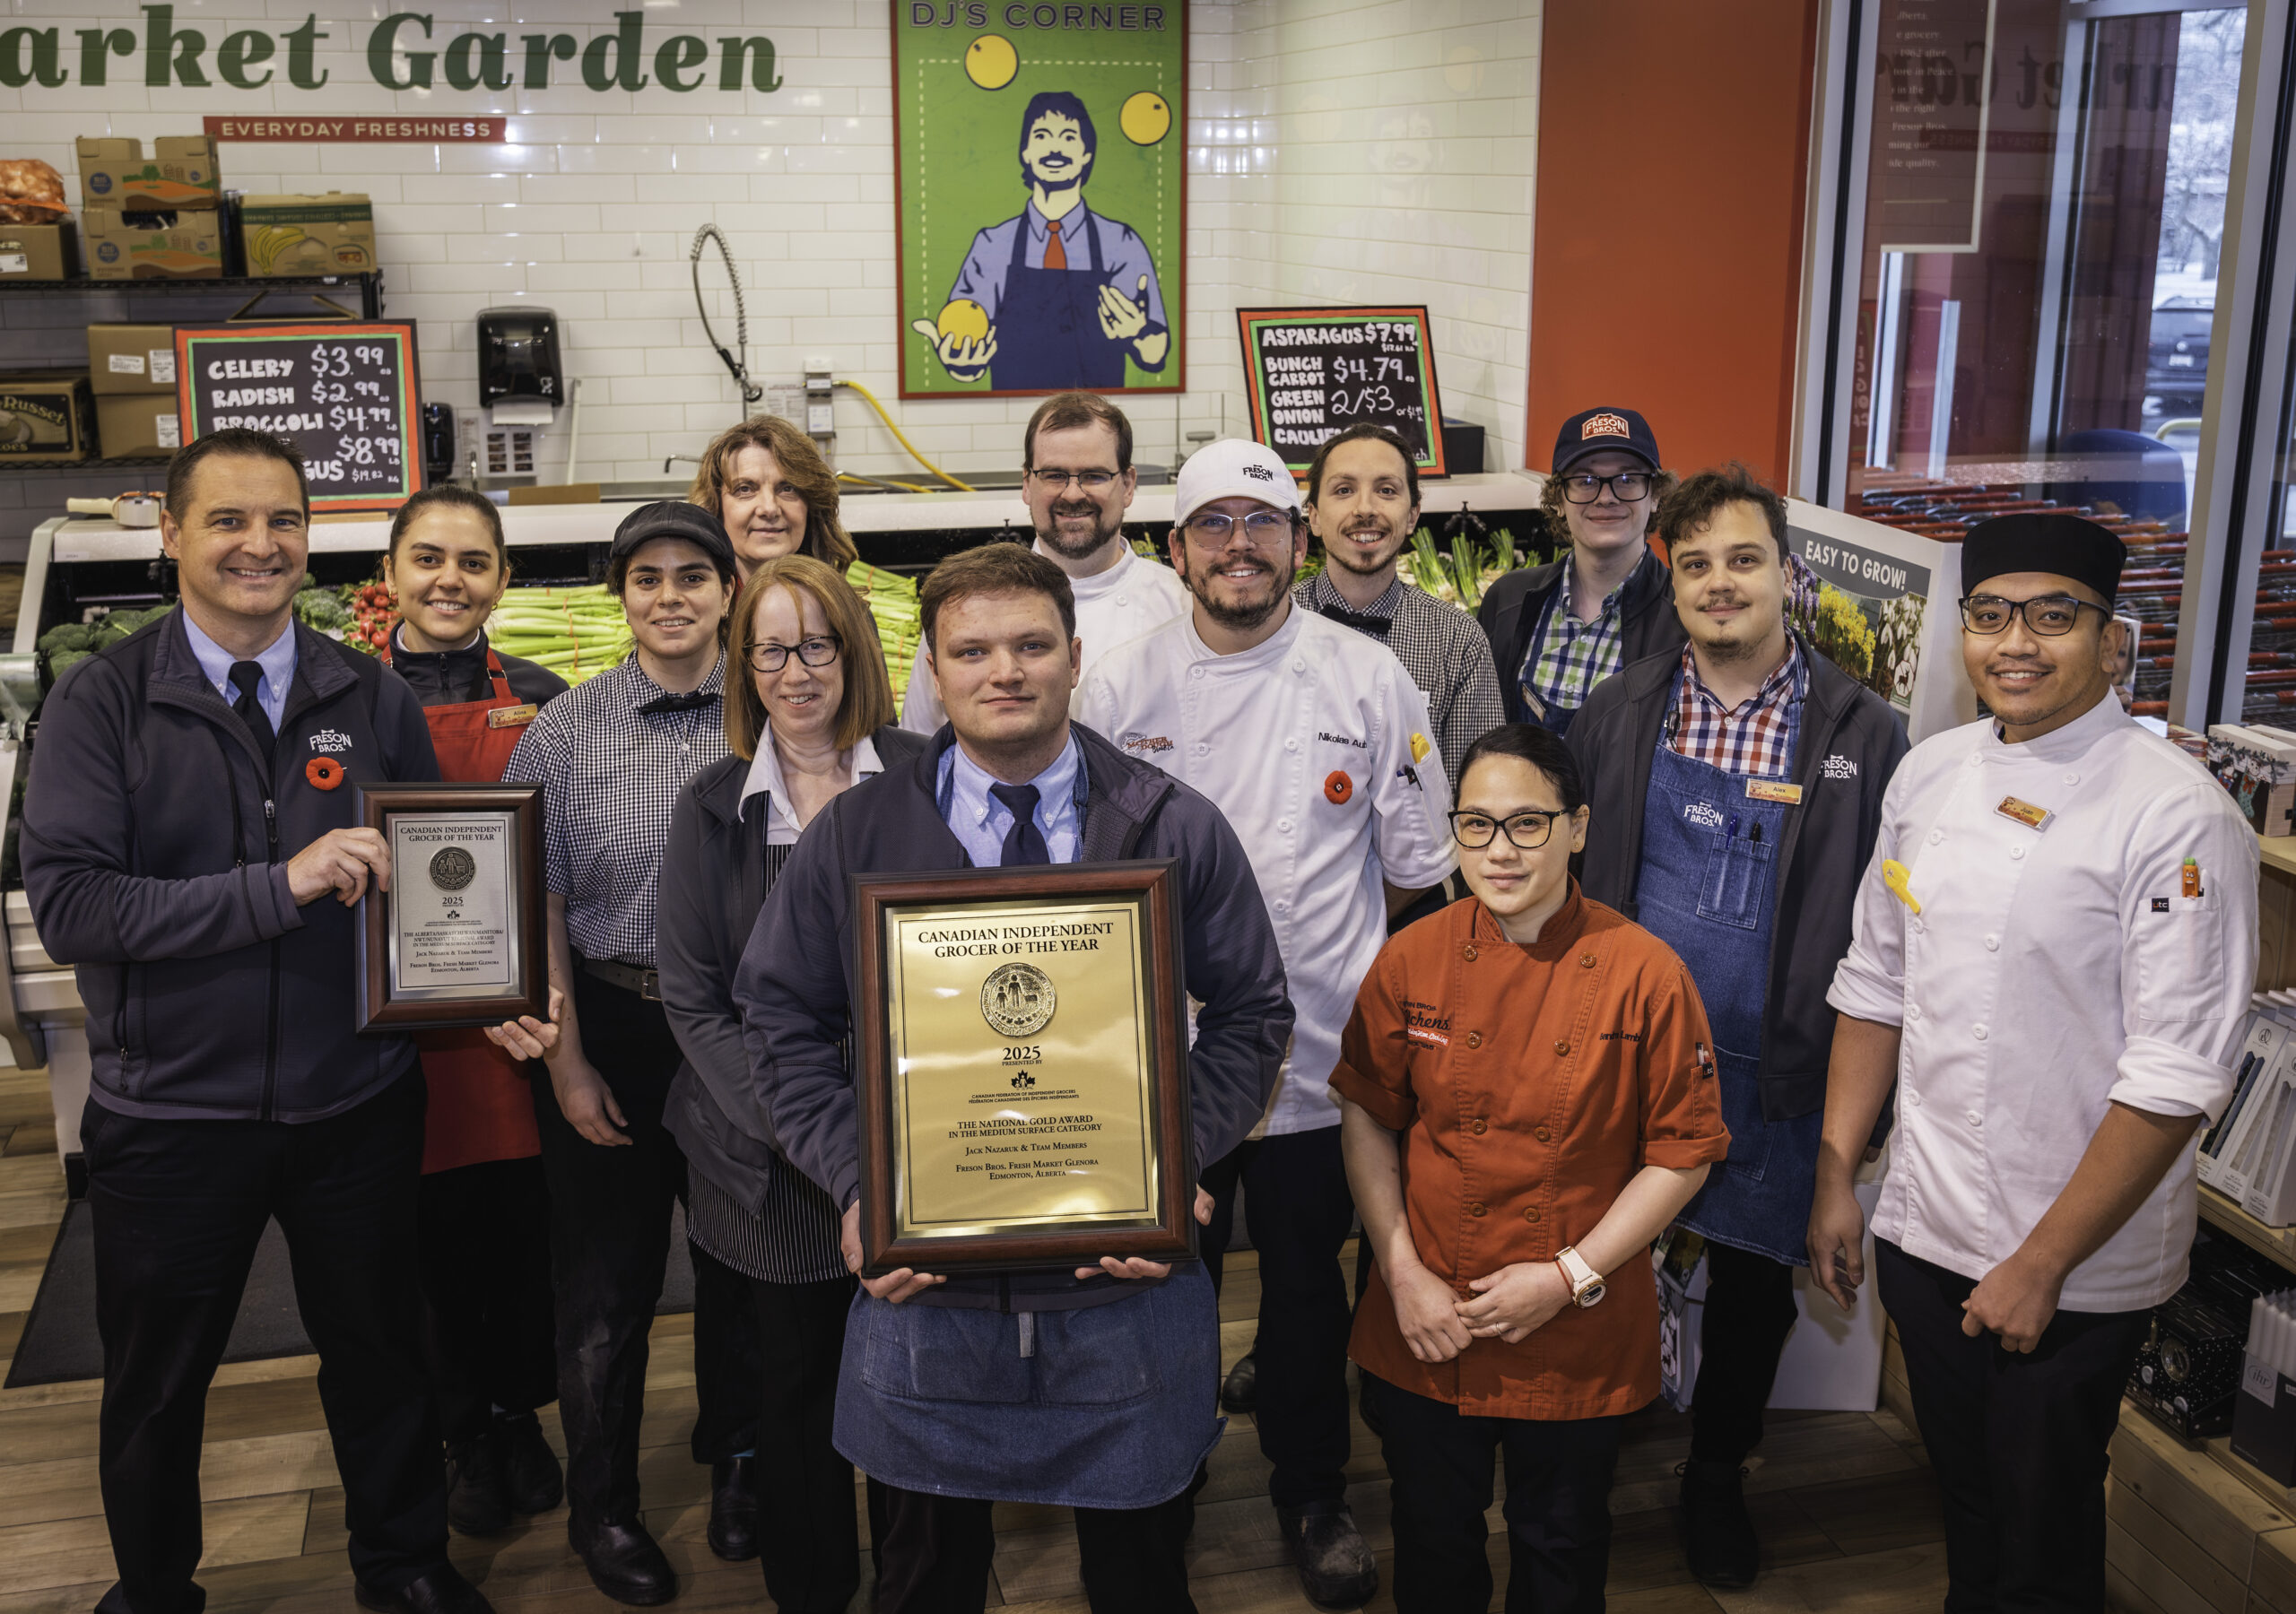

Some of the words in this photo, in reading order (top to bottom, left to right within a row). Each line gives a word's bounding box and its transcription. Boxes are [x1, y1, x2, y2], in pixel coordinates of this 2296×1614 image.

[910, 1, 990, 29] DJ'S
[1002, 4, 1166, 30] CORNER
[0, 4, 331, 91] arket
[367, 11, 784, 93] Garden
[222, 122, 344, 136] EVERYDAY
[355, 122, 491, 136] FRESHNESS
[1262, 326, 1364, 346] ASPARAGUS
[1364, 322, 1415, 344] $7.99
[208, 359, 294, 380] CELERY
[310, 343, 384, 377] $3.99
[1265, 357, 1323, 373] BUNCH
[1333, 356, 1404, 383] $4.79
[1268, 371, 1326, 386] CARROT
[212, 386, 295, 409] RADISH
[311, 380, 379, 404] $2.99
[1271, 389, 1325, 407] GREEN
[1331, 386, 1395, 414] 2/$3
[3, 395, 67, 427] Russet
[213, 413, 324, 432] BROCCOLI
[329, 404, 391, 431] $4.99
[1272, 408, 1325, 424] ONION
[1586, 418, 1626, 434] FRESON
[335, 434, 400, 464] $8.99
[1242, 466, 1274, 481] FRESON
[1805, 540, 1839, 568] EASY
[1841, 551, 1859, 574] TO
[1862, 558, 1907, 591] GROW!
[309, 733, 352, 751] FRESON
[1318, 732, 1350, 745] Nikolas
[317, 743, 346, 753] BROS.
[1824, 769, 1851, 779] BROS.
[1683, 804, 1724, 826] FRESON
[1690, 814, 1715, 827] BROS.
[442, 897, 463, 905] 2025
[918, 928, 998, 943] CANADIAN
[1004, 922, 1113, 939] INDEPENDENT
[935, 943, 998, 958] GROCER
[1002, 941, 1022, 955] OF
[1026, 941, 1057, 953] THE
[1060, 938, 1099, 950] YEAR
[1003, 1046, 1040, 1060] 2025
[949, 1131, 958, 1139] IN
[960, 1130, 978, 1138] THE
[979, 1129, 1016, 1137] MEDIUM
[1018, 1126, 1055, 1135] SURFACE
[1057, 1124, 1102, 1132] CATEGORY
[957, 1121, 977, 1130] THE
[978, 1119, 1027, 1129] NATIONAL
[1029, 1117, 1057, 1126] GOLD
[1058, 1115, 1093, 1124] AWARD
[2252, 1369, 2269, 1385] ihr
